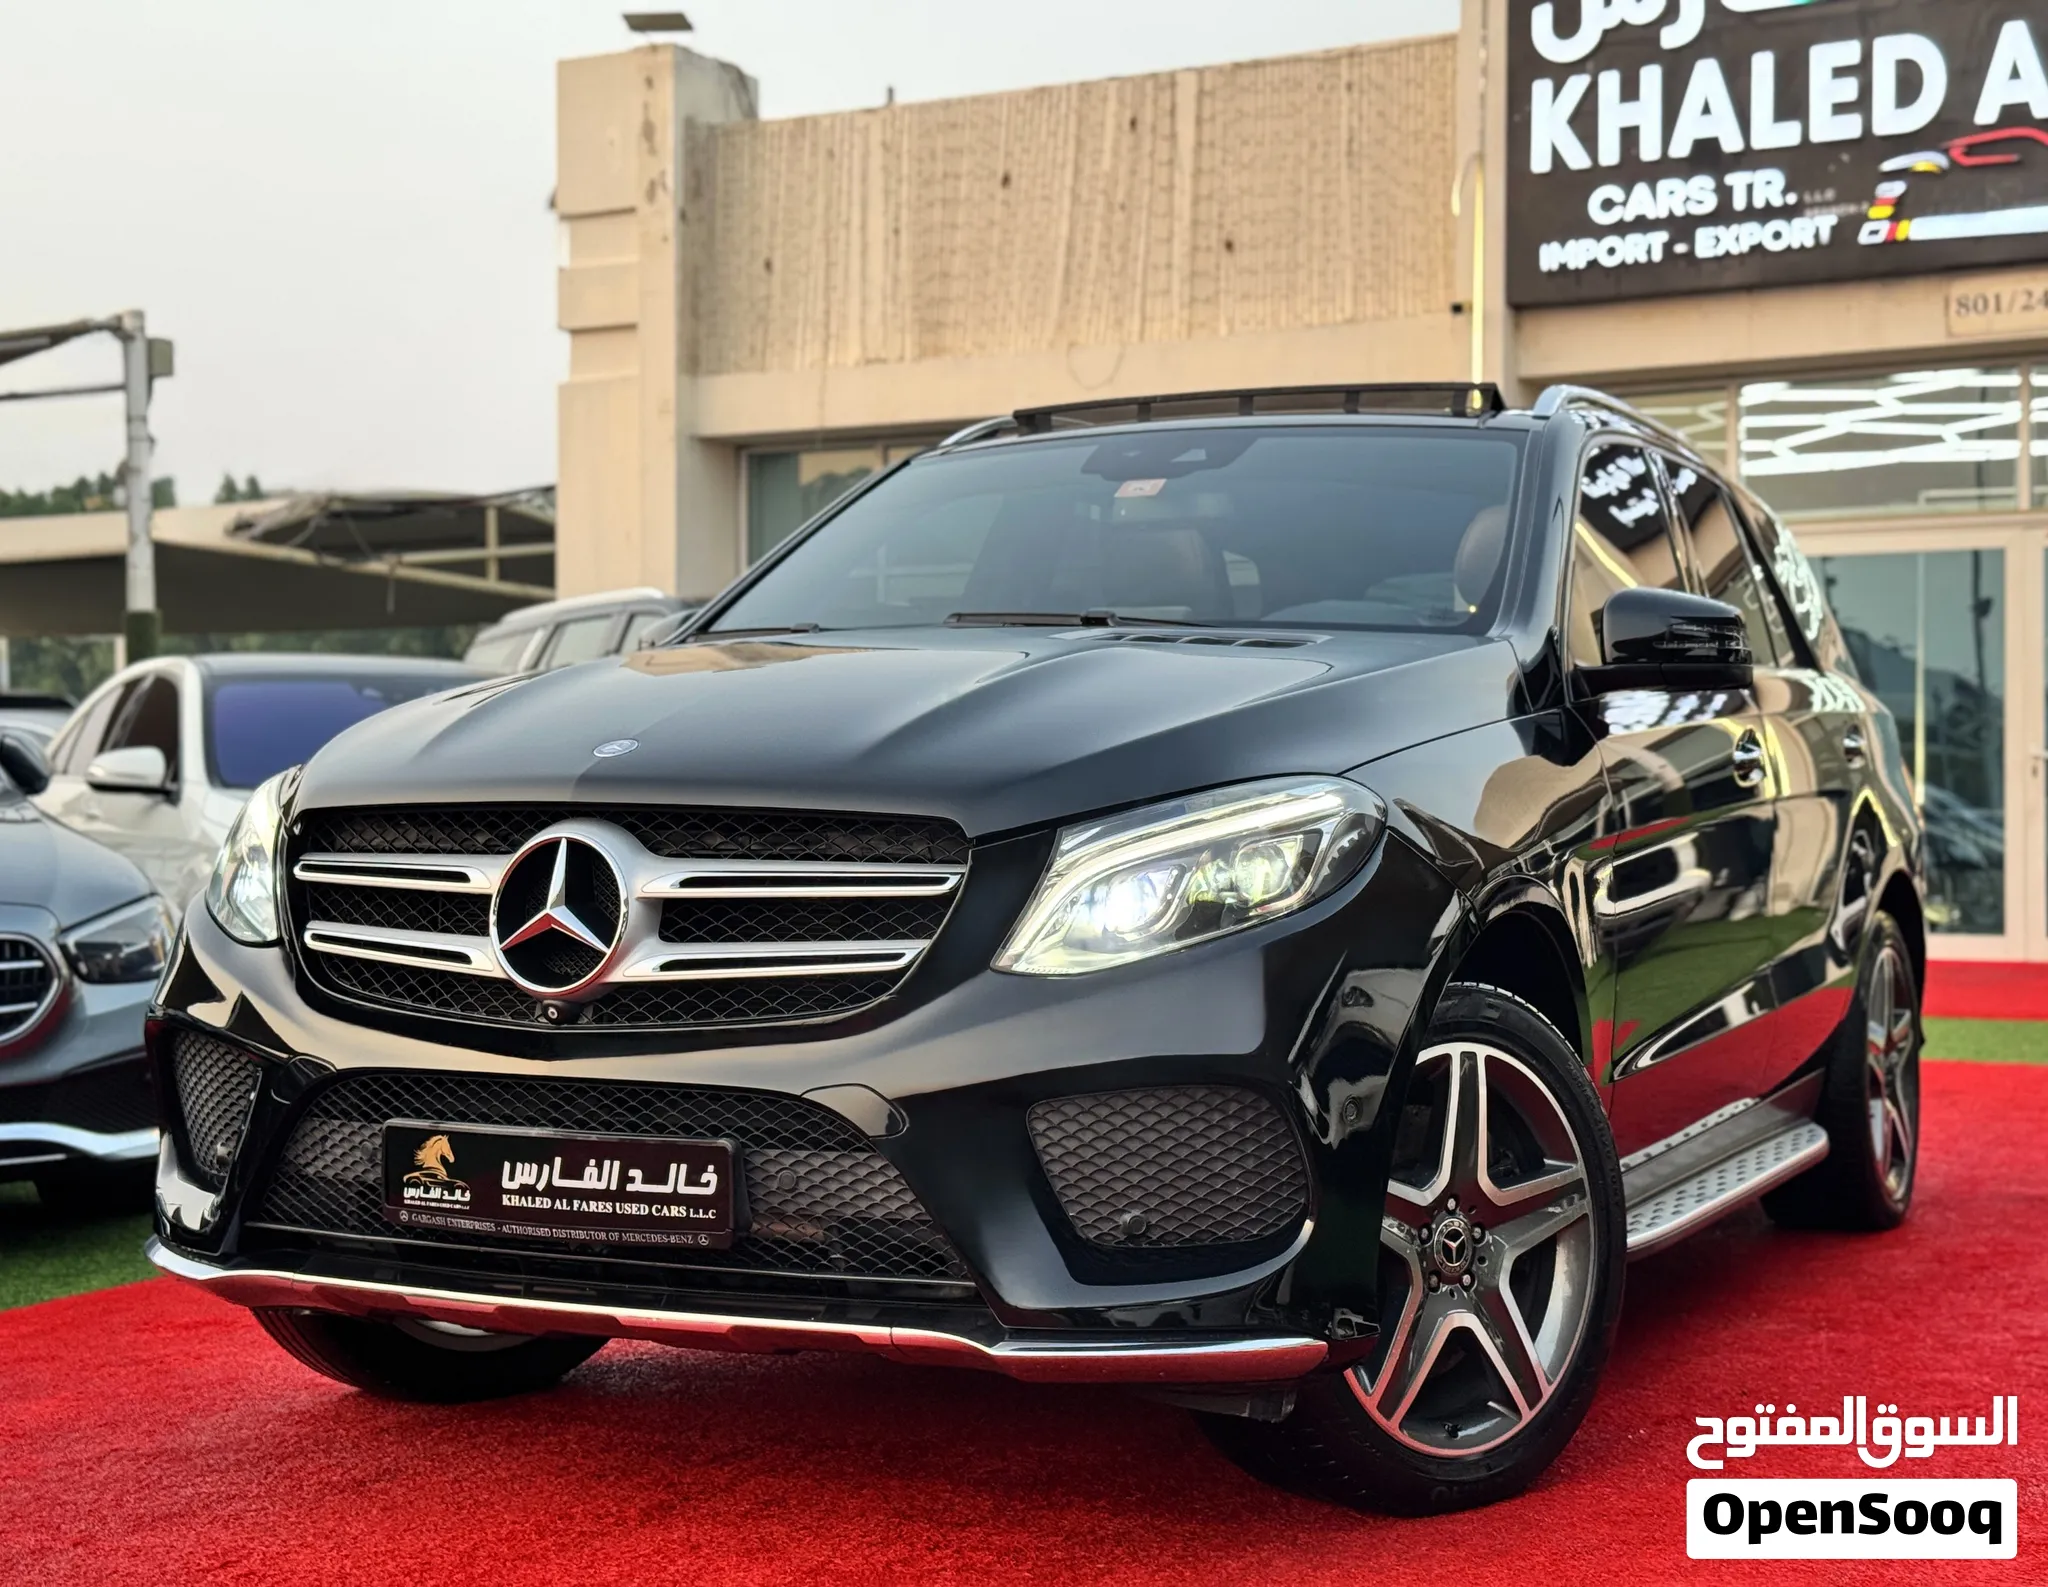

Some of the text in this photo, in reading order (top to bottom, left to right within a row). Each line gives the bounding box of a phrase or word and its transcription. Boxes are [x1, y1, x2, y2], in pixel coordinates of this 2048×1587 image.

[1530, 33, 1948, 173] KHALED
[1588, 177, 1718, 224] CARS
[1724, 168, 1798, 211] TR.
[1539, 232, 1668, 271] IMPORT
[1695, 215, 1838, 258] EXPORT
[502, 1156, 718, 1195] خالد الفارس
[411, 1213, 446, 1226] GARGASH
[448, 1217, 495, 1231] ENTERPRISES
[502, 1224, 551, 1237] AUTHORISED
[552, 1228, 607, 1241] DISTRIBUTOR
[608, 1232, 619, 1241] OF
[622, 1232, 693, 1244] MERCEDES-BENZ
[502, 1194, 716, 1219] KHALED AL FARES USED CARS L.L.C
